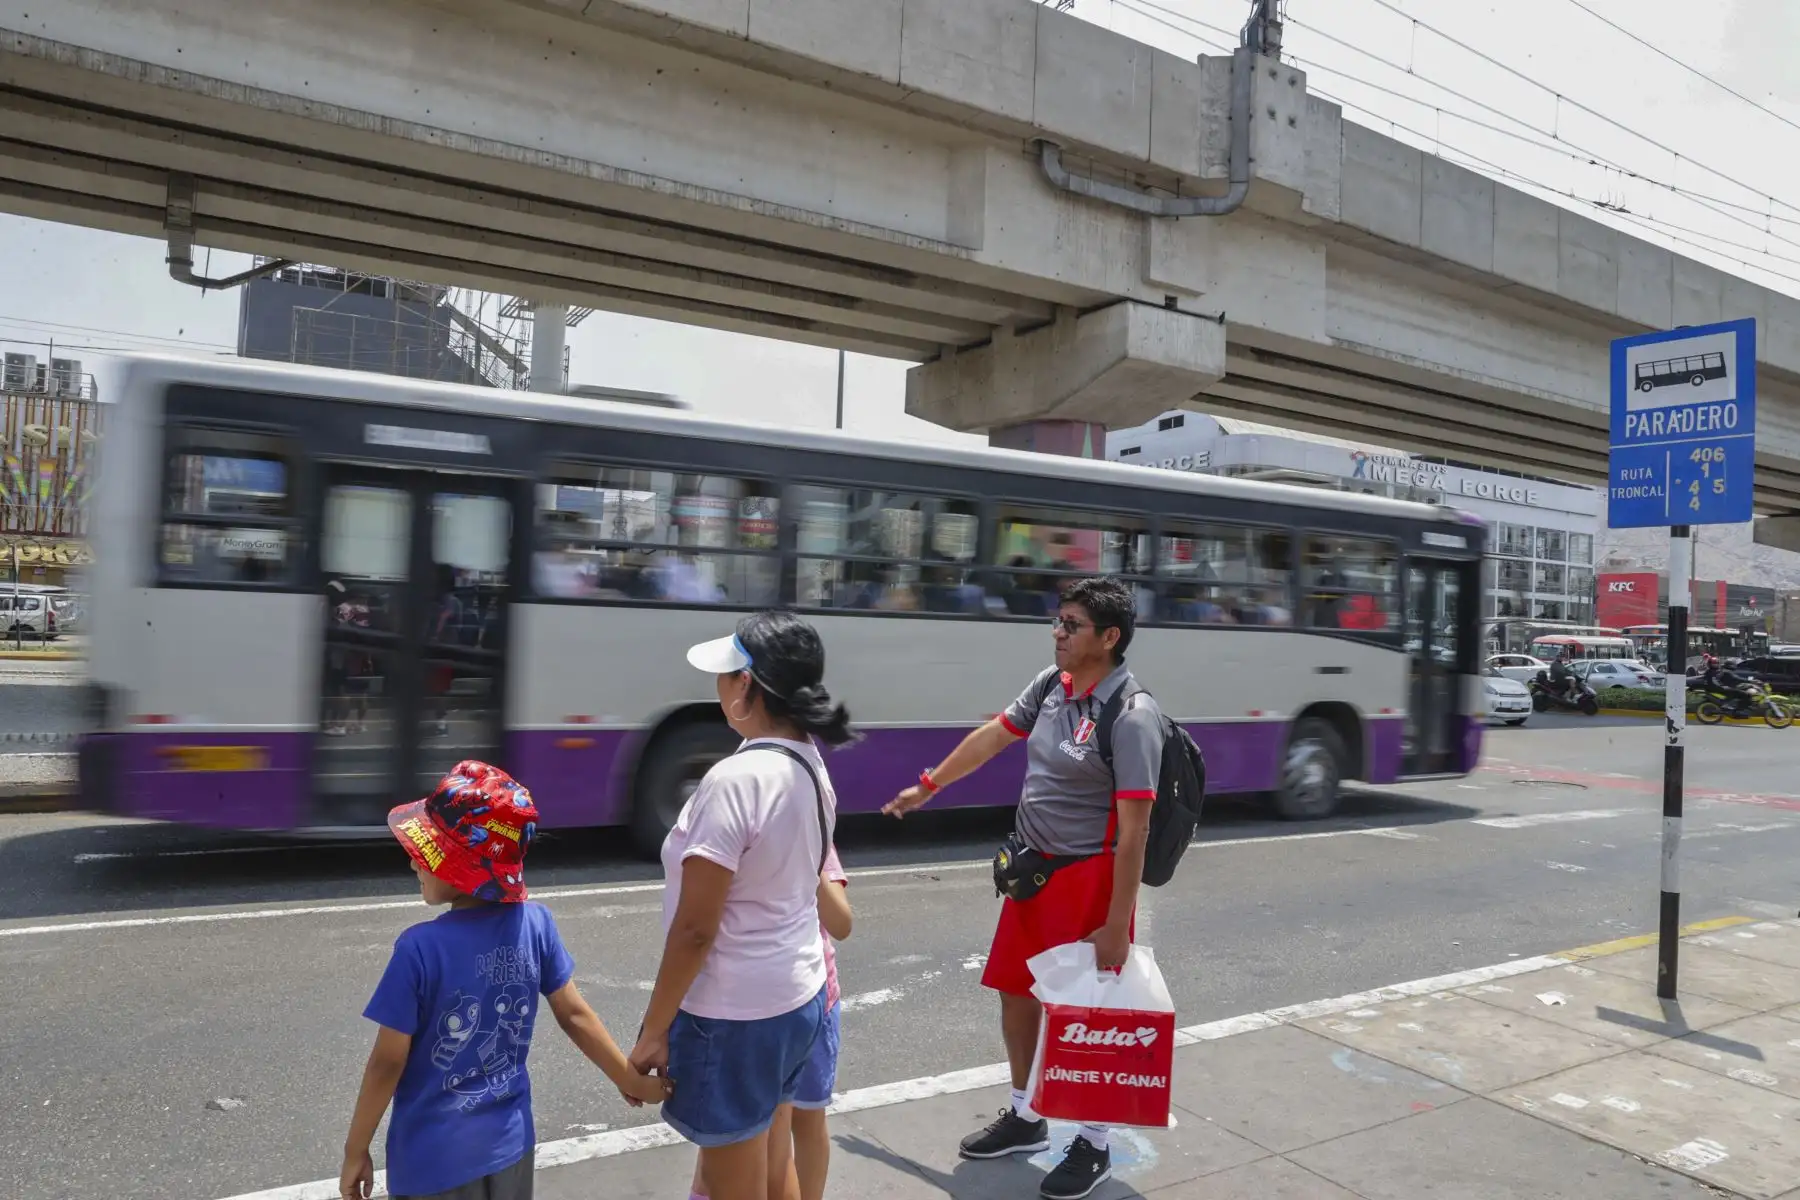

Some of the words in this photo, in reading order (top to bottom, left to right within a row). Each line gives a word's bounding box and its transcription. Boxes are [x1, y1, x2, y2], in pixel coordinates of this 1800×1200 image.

[1625, 403, 1738, 438] PARADERO
[1690, 447, 1725, 462] 406
[1371, 454, 1448, 474] GIMNASIOS
[1701, 462, 1710, 478] 1
[1621, 467, 1652, 480] RUTA
[1370, 463, 1447, 491] MEGA
[1460, 478, 1539, 505] FORCE
[1611, 483, 1664, 499] TRONCAL
[1688, 479, 1700, 495] 4
[1712, 478, 1724, 494] 5
[1688, 496, 1700, 511] 4
[1608, 581, 1635, 592] KFC
[1058, 1022, 1138, 1047] Bata
[1103, 1073, 1113, 1084] Y
[1116, 1072, 1166, 1088] GANA!
